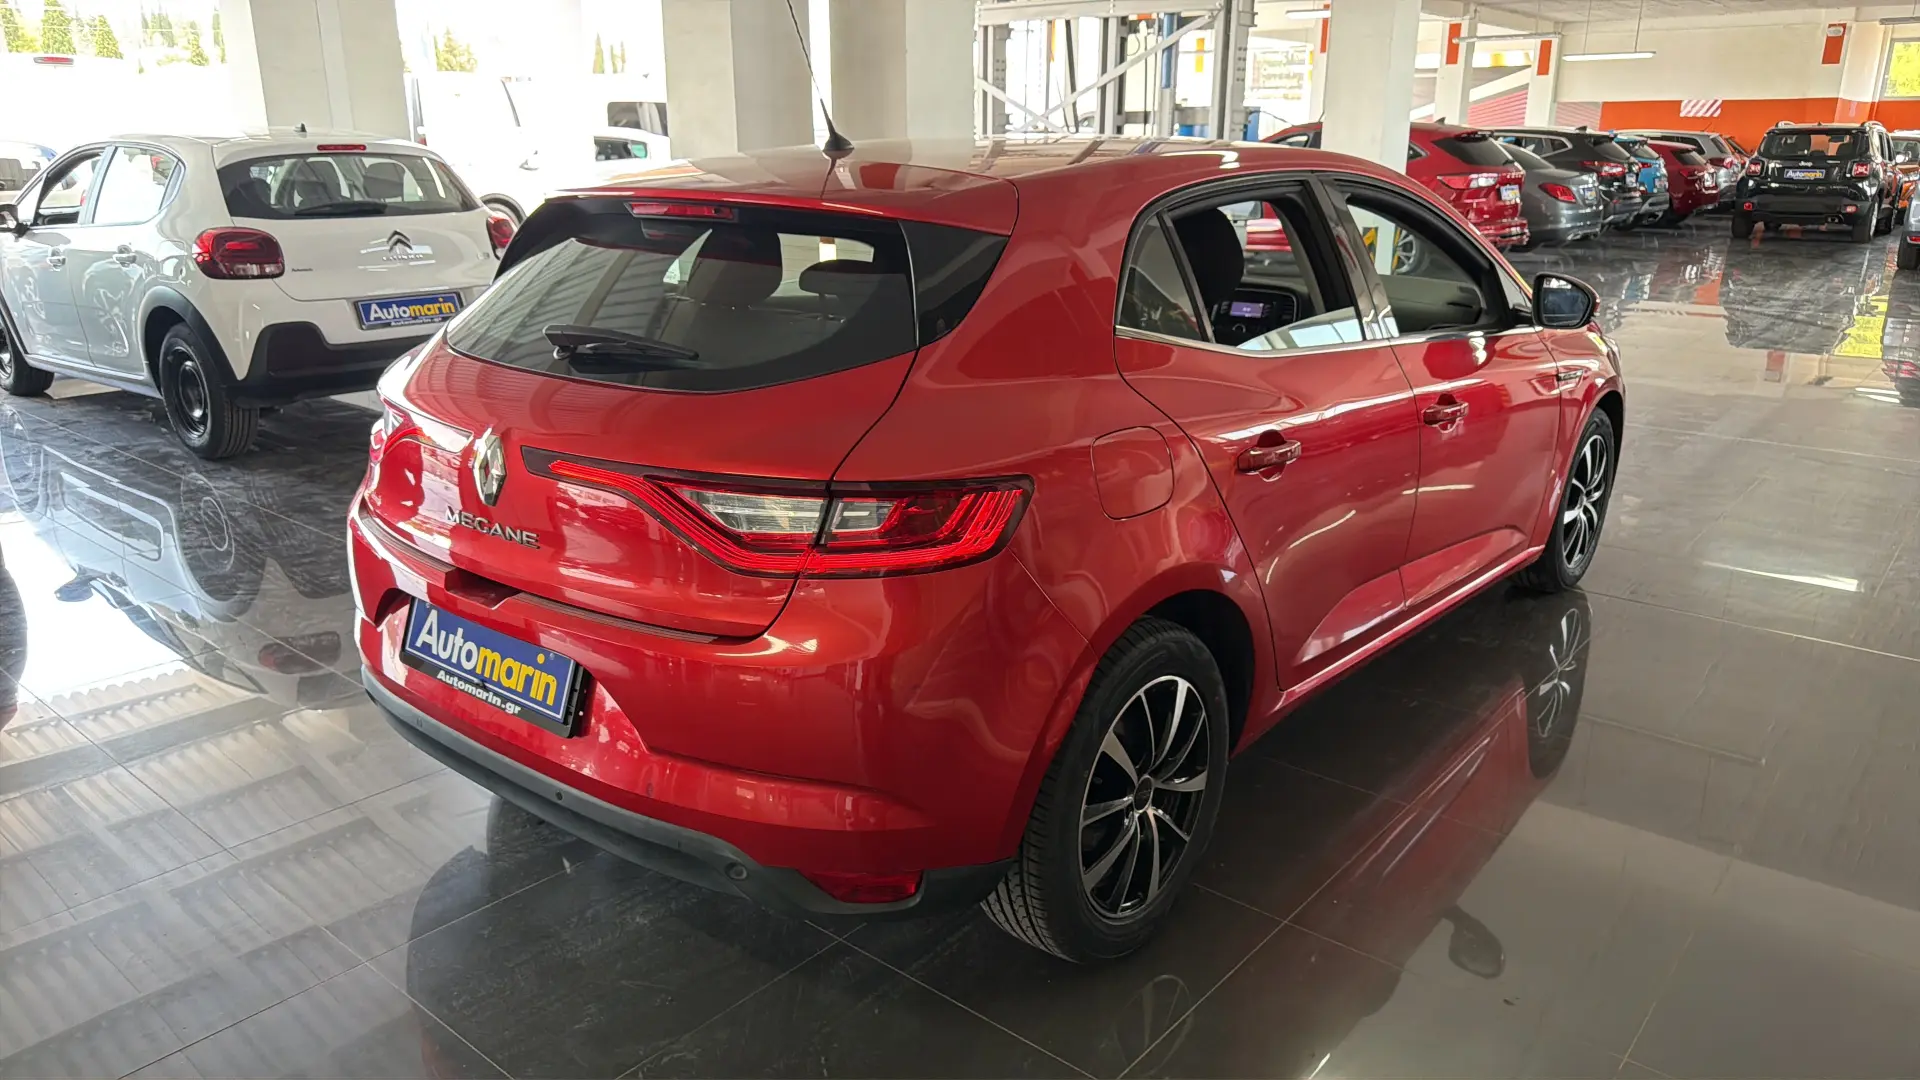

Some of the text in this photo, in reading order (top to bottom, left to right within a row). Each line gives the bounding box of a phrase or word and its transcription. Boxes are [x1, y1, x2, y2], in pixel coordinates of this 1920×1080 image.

[369, 298, 455, 321] Automarin
[445, 505, 540, 549] MEGANE
[415, 609, 557, 706] Automarin
[437, 670, 521, 714] Automarin.gr
